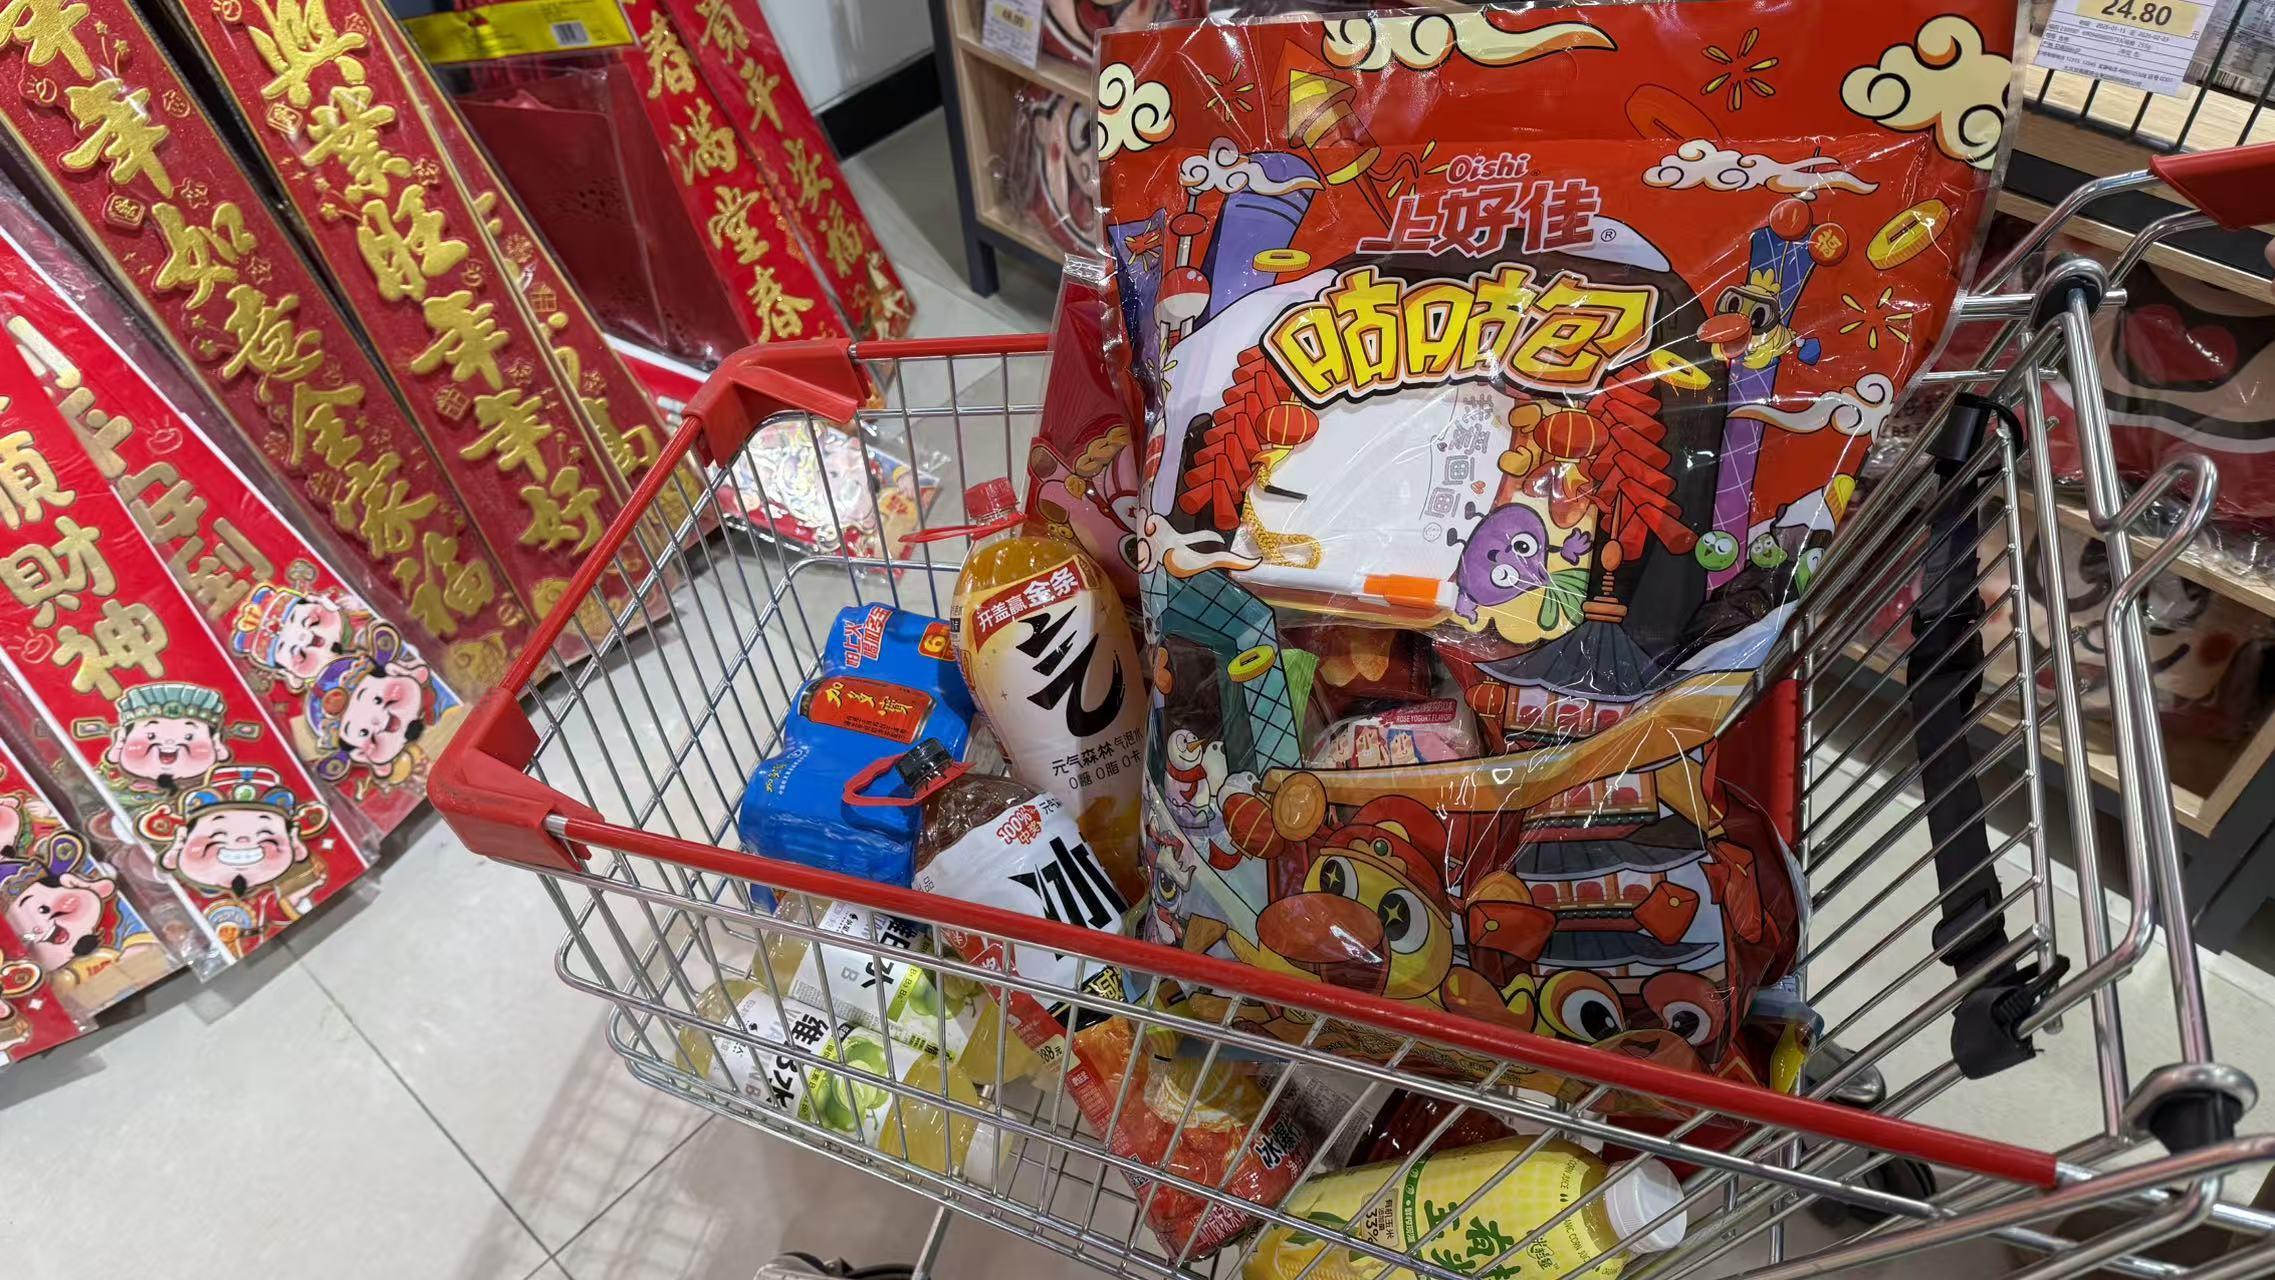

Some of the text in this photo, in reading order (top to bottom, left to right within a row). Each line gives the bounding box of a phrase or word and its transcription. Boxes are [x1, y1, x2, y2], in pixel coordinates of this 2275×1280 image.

[2101, 0, 2172, 26] 24.80
[2190, 31, 2199, 40] 元
[1446, 153, 1529, 185] Oishi
[1357, 178, 1602, 257] 上好佳
[1268, 264, 1658, 396] 咕咕包
[977, 567, 1079, 633] 开盖赢金条
[1052, 727, 1144, 777] 元气森林 气泡水
[1069, 750, 1142, 790] 0糖 0脂 0卡
[997, 805, 1035, 844] 100%
[1020, 820, 1042, 844] 中奖
[1254, 1116, 1302, 1170] 冰爆
[1366, 1208, 1379, 1243] 33%
[1568, 1232, 1583, 1252] CORN
